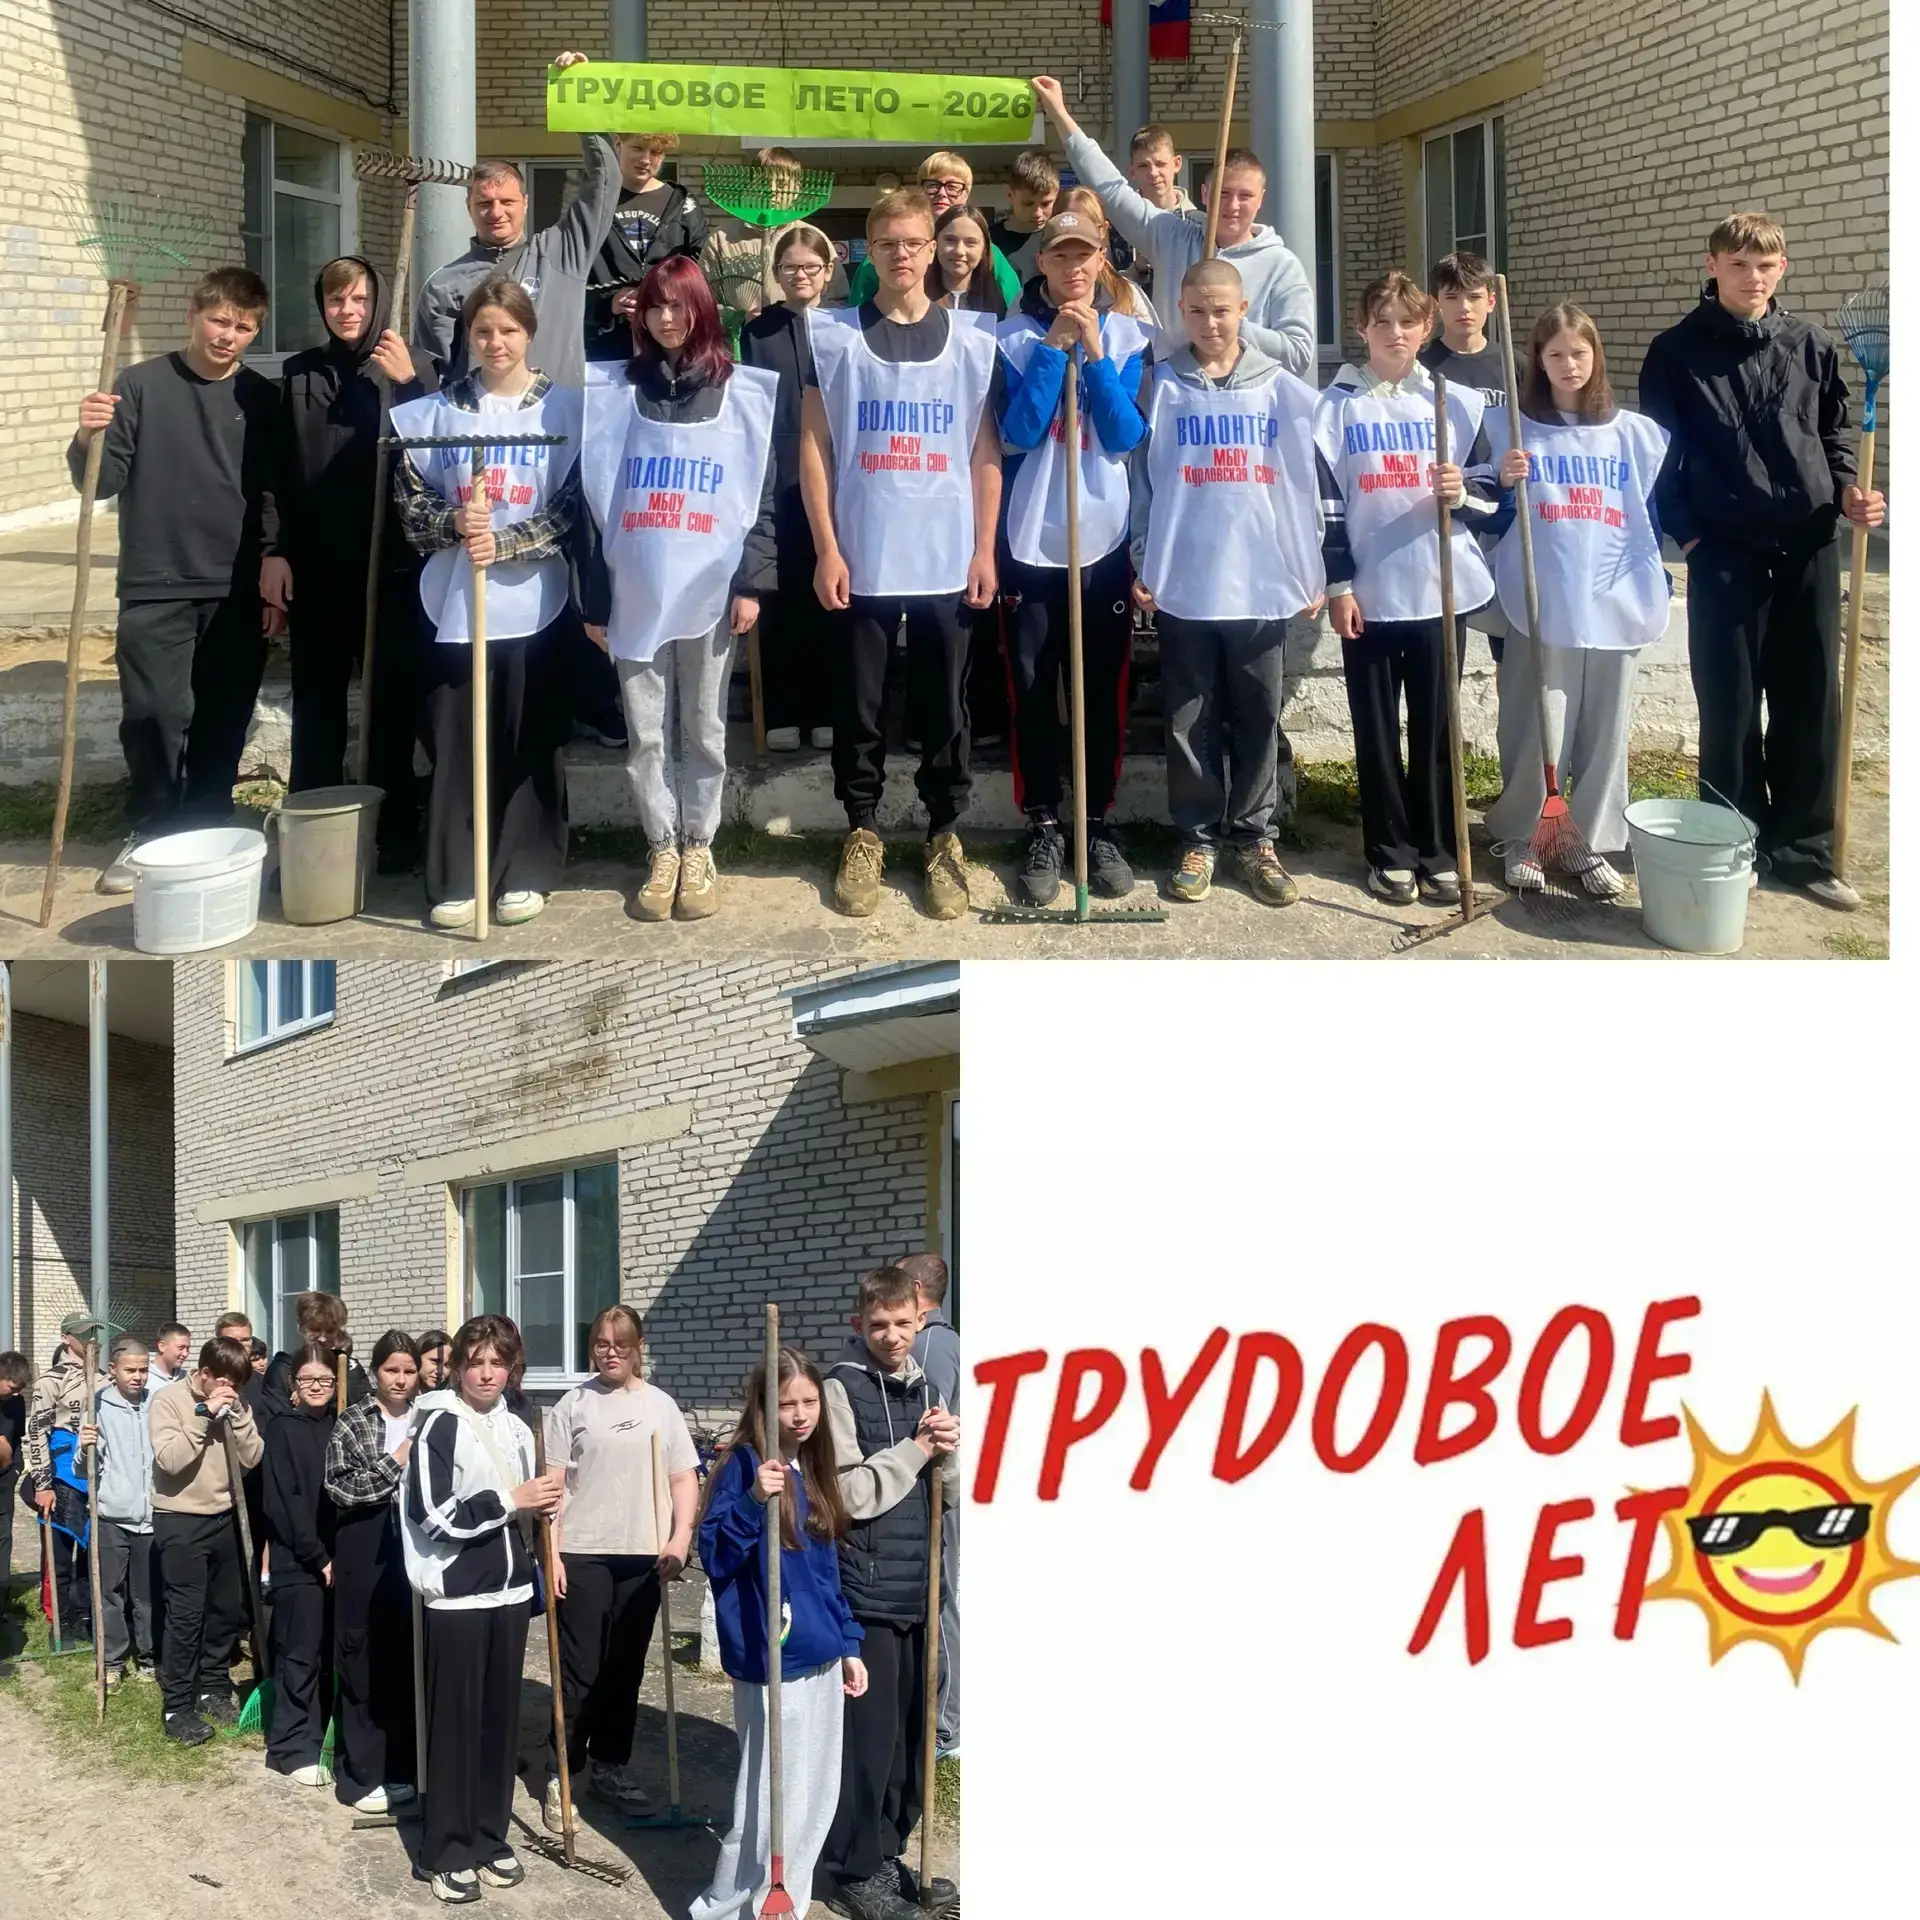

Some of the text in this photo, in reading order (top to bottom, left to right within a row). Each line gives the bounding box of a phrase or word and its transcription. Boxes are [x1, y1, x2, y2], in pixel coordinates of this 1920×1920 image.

[550, 78, 766, 110] ТРУДОВОЕ
[796, 84, 899, 114] ЛЕТО
[943, 90, 1032, 119] 2026
[858, 398, 954, 434] ВОЛОНТЁР
[1176, 412, 1278, 448] ВОЛОНТЁР
[1345, 416, 1437, 455] ВОЛОНТЁ
[890, 435, 921, 455] МБОУ
[1213, 448, 1248, 467] МБОУ
[1382, 454, 1418, 472] МБОУ
[482, 468, 508, 486] БОУ
[1529, 455, 1630, 490] ВОЛОНТЁР
[648, 492, 686, 512] МБОУ
[1569, 487, 1603, 505] МБОУ
[30, 1443, 42, 1466] LAST
